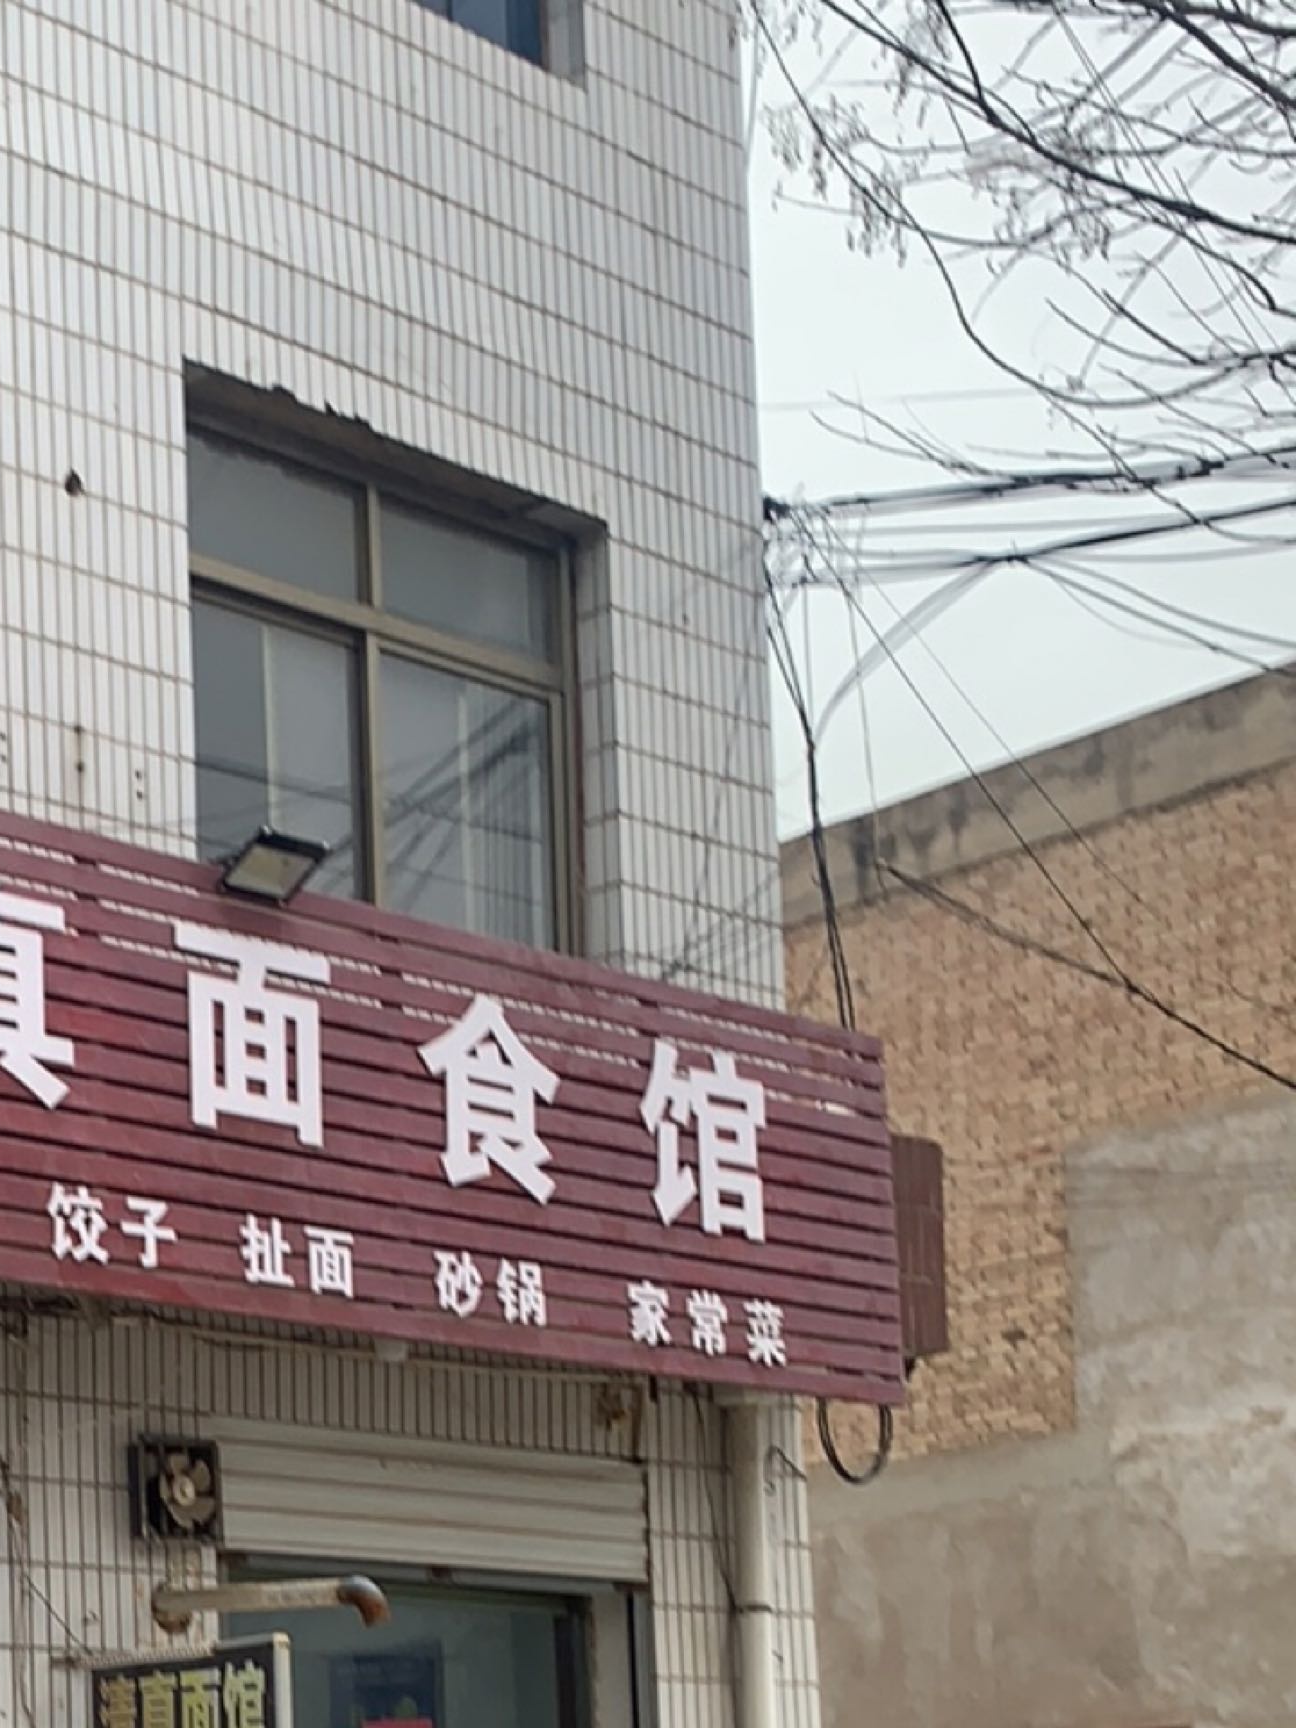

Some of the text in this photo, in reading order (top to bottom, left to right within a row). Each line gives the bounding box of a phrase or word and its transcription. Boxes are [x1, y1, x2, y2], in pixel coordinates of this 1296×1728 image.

[47, 1181, 177, 1268] 饺子
[239, 1213, 354, 1298] 扯面
[433, 1249, 547, 1327] 砂锅
[627, 1280, 787, 1367] 家常菜
